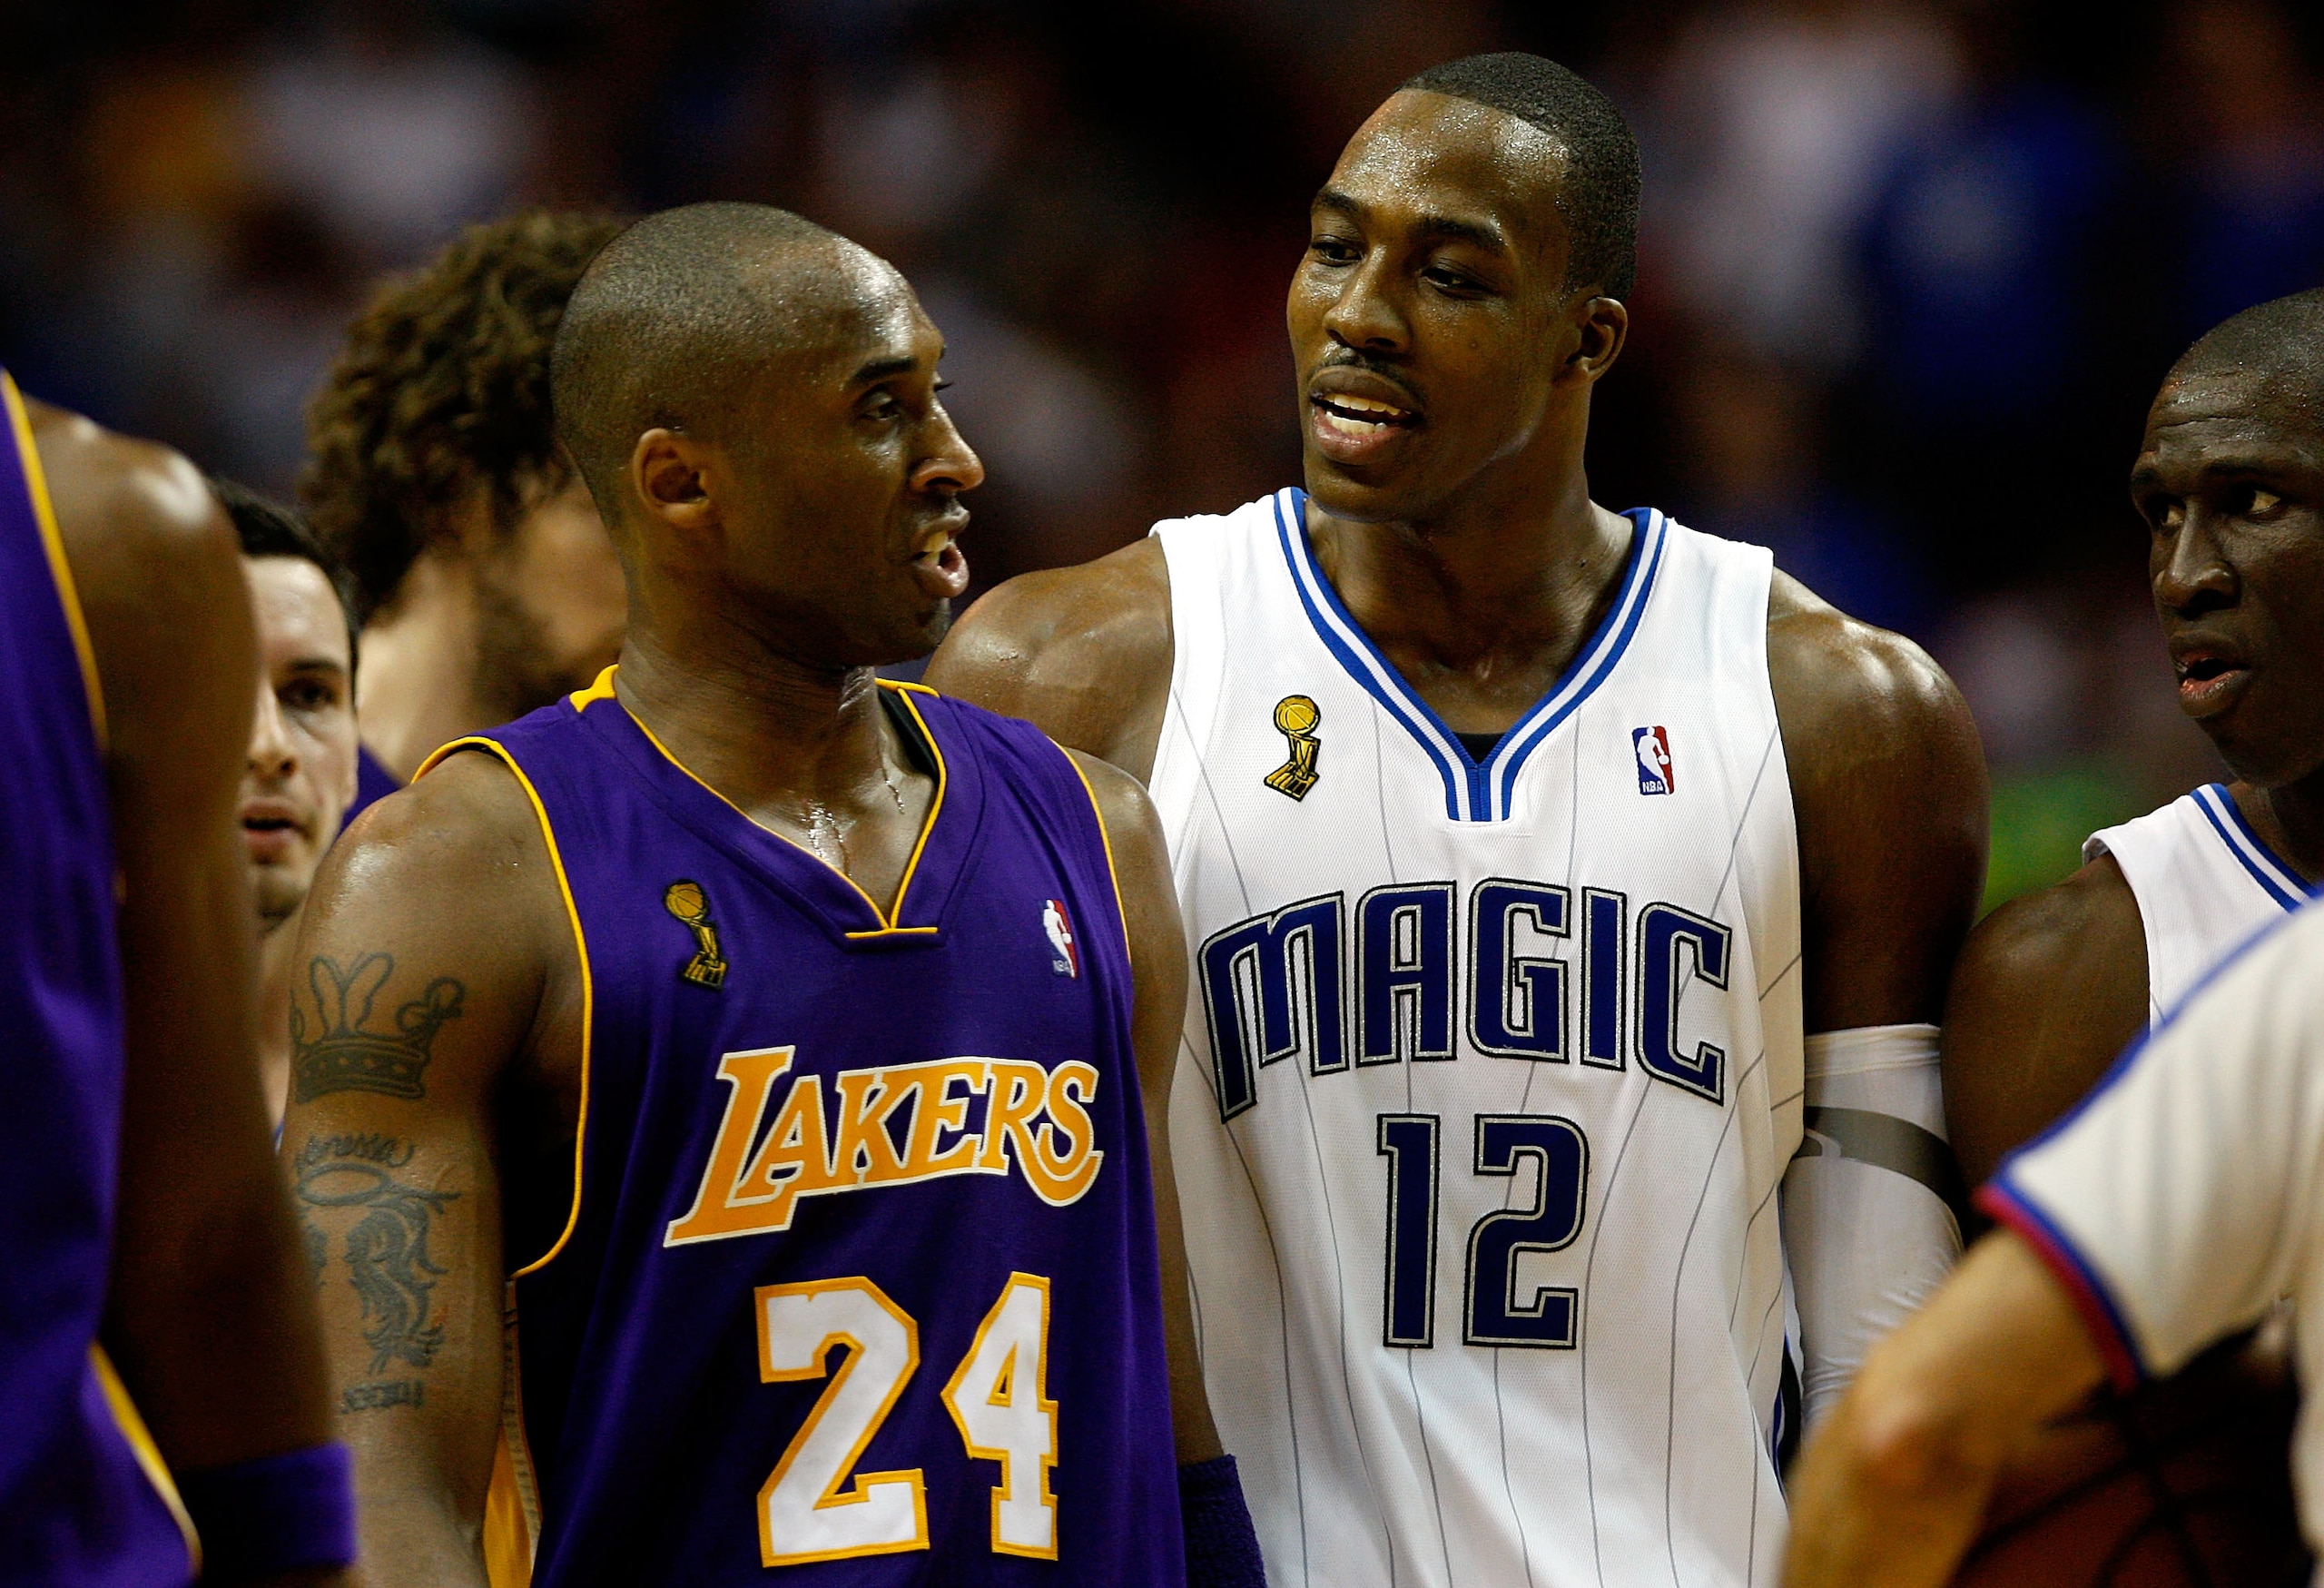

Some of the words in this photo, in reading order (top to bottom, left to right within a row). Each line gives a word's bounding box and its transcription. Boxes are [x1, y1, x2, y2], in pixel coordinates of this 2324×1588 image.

[1642, 781, 1664, 793] NBA
[1198, 877, 1732, 1124] MAGIC
[664, 1045, 1104, 1248] LAKERS
[1376, 1113, 1590, 1349] 12
[754, 1272, 1059, 1568] 24
